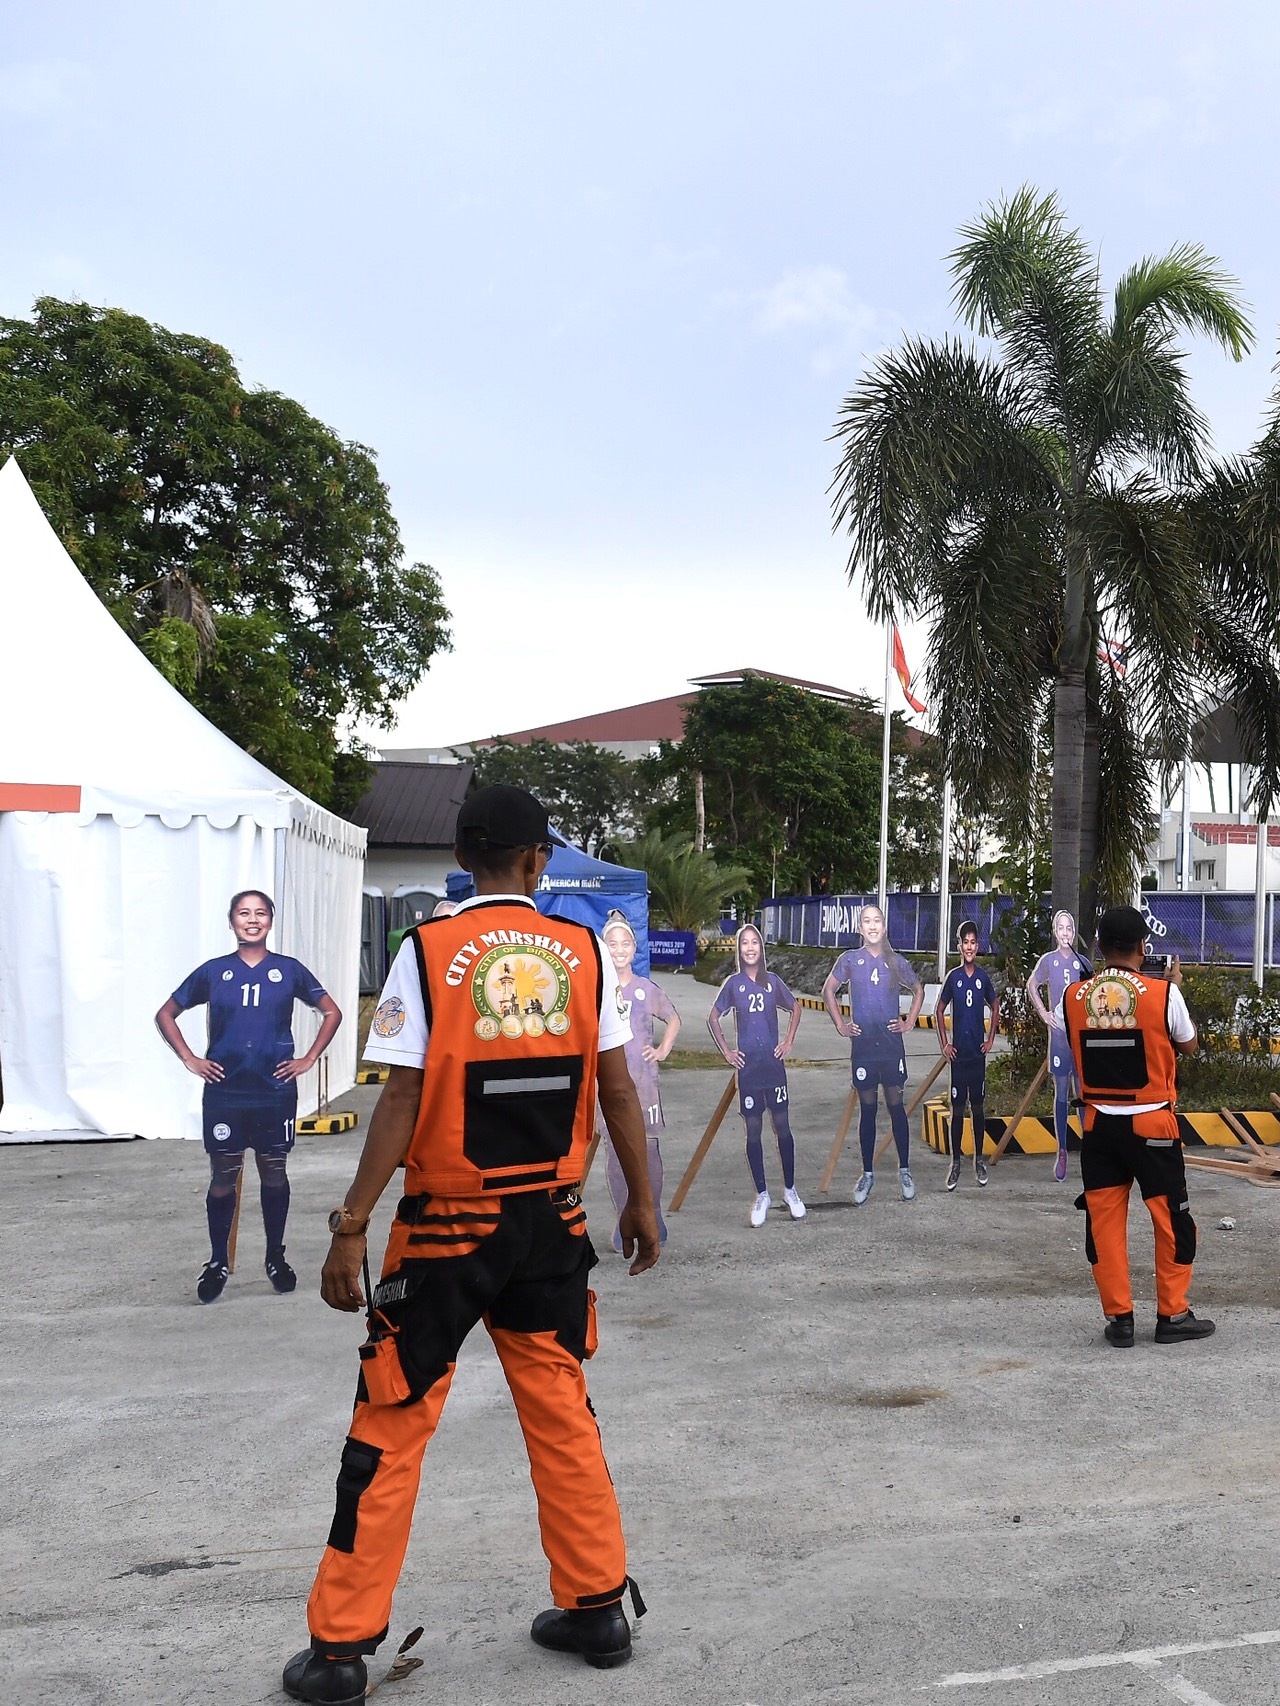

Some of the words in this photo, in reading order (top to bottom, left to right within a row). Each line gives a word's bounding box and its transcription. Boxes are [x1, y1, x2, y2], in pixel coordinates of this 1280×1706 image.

[540, 874, 580, 891] AMERICAN
[445, 940, 481, 987] CITY
[479, 929, 582, 973] MARSHALL
[479, 952, 498, 973] CITY
[870, 967, 880, 985] 4
[1063, 968, 1070, 984] 5
[240, 983, 260, 1007] 11
[748, 993, 765, 1013] 23
[966, 989, 973, 1008] 8
[774, 1085, 787, 1104] 23
[648, 1103, 659, 1125] 17
[283, 1118, 294, 1142] 11
